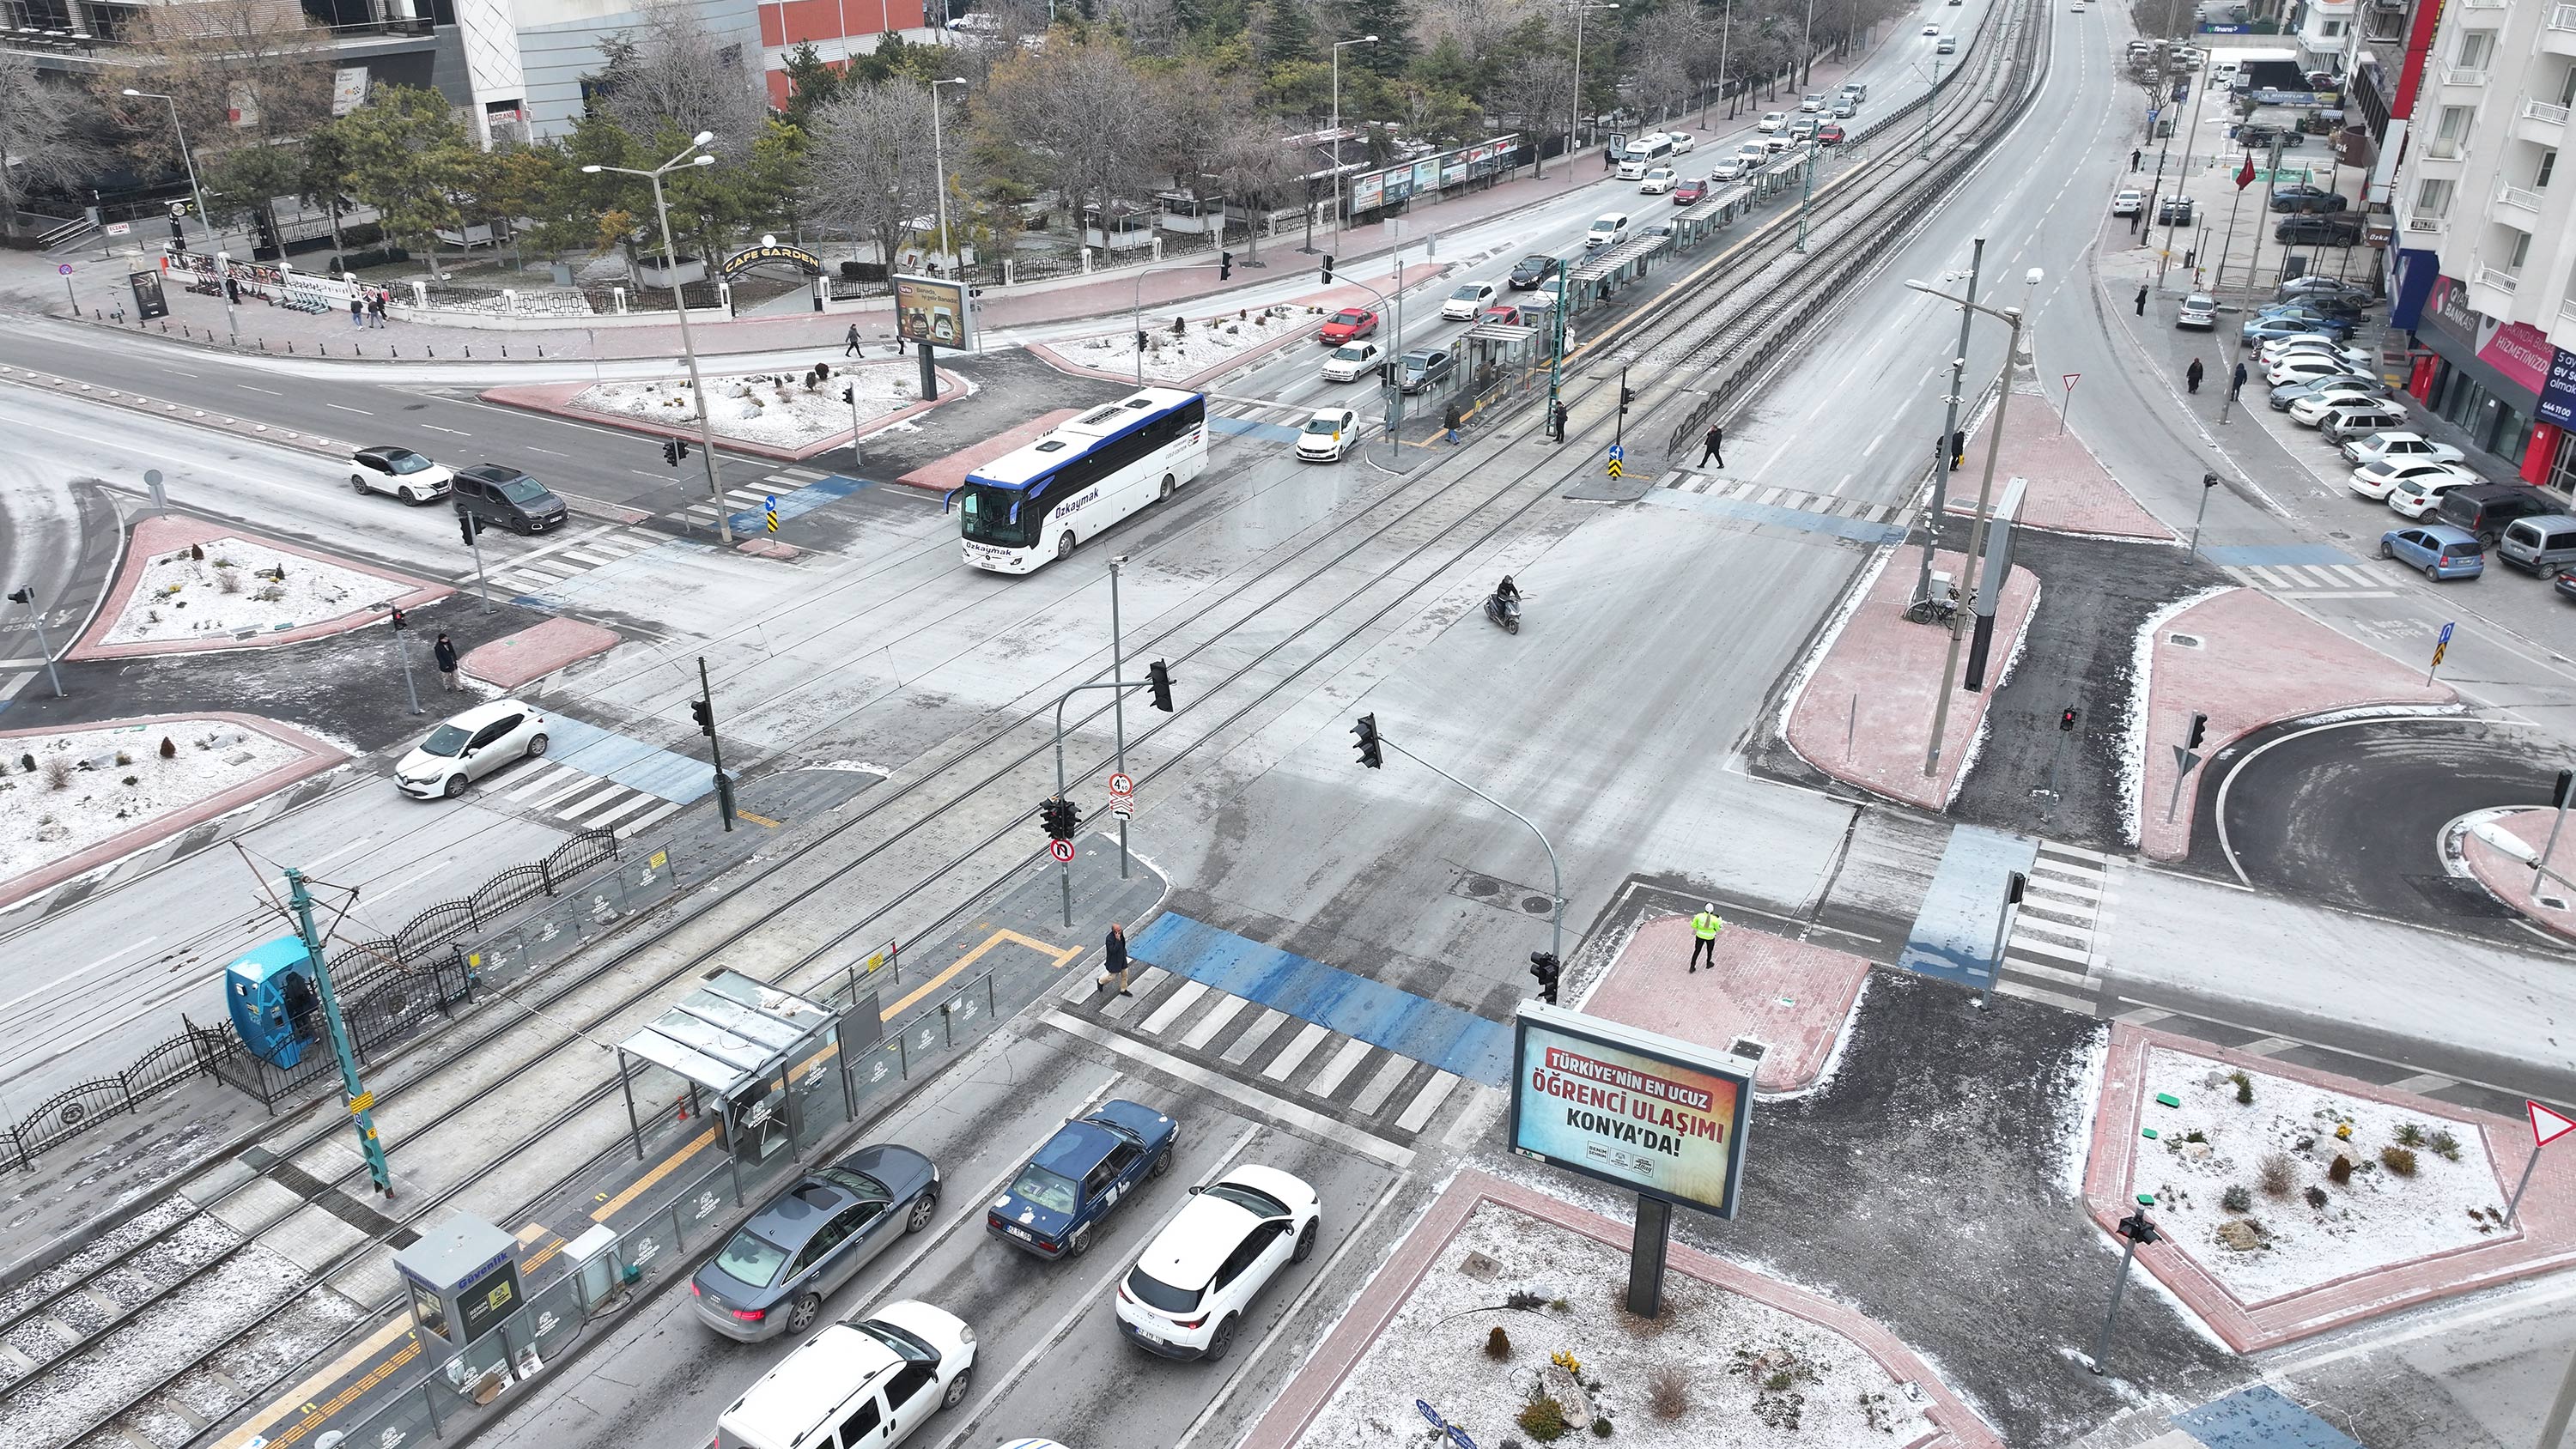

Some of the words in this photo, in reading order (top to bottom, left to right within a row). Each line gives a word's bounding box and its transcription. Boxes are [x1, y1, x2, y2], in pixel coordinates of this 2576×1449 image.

[726, 251, 759, 272] CAFE
[762, 249, 818, 268] GARDEN
[2445, 302, 2475, 332] BANKASI
[2558, 352, 2566, 362] 5
[2554, 367, 2567, 378] ev
[2543, 402, 2555, 411] 444
[2561, 408, 2571, 417] 00
[1055, 488, 1099, 518] Özkaymak
[1115, 779, 1121, 790] 4
[1552, 1052, 1643, 1090] TÜRKİYE'NİN
[1645, 1079, 1665, 1097] EN
[1668, 1087, 1708, 1108] UCUZ
[1532, 1067, 1626, 1115] ÖĞRENCİ
[1632, 1099, 1724, 1143] ULAŞIMI
[1567, 1107, 1681, 1157] KONYA'DA!
[401, 1265, 437, 1292] Güvenlik
[459, 1252, 508, 1289] Güvenlik
